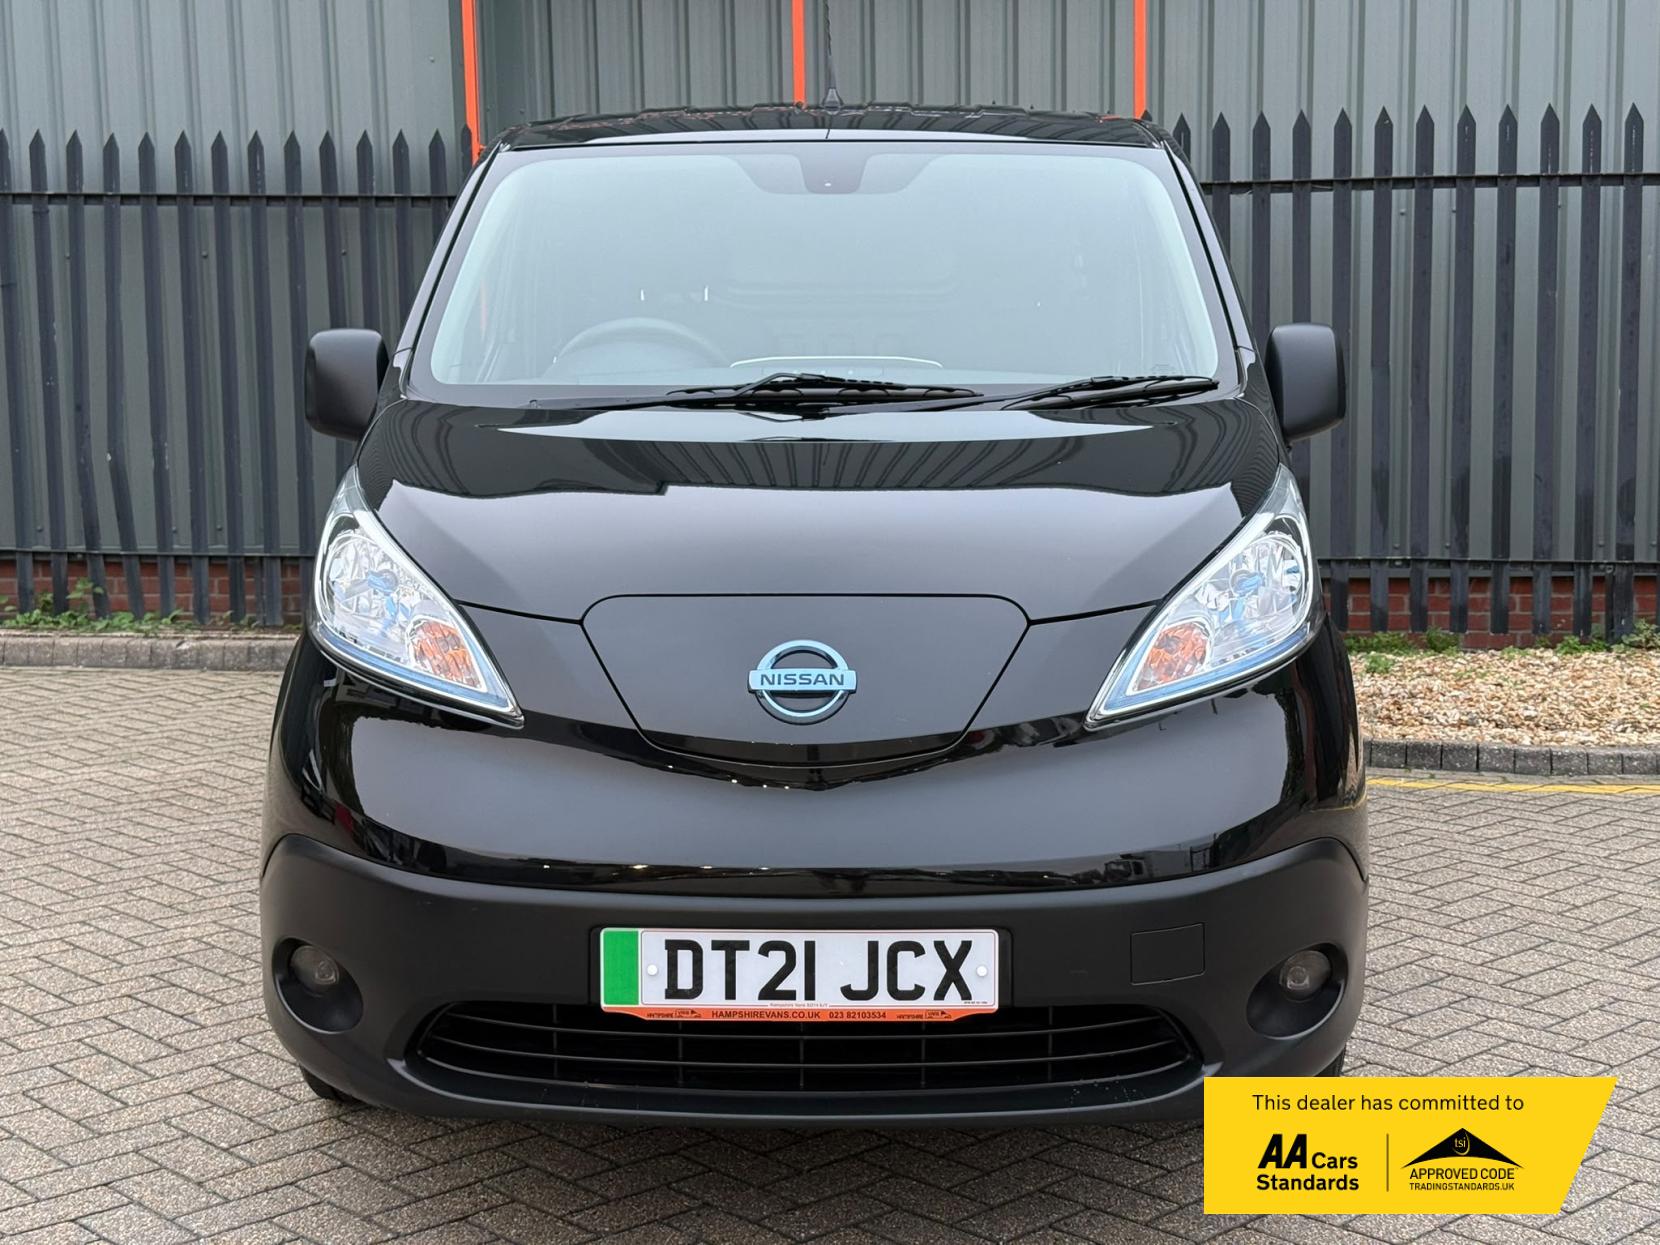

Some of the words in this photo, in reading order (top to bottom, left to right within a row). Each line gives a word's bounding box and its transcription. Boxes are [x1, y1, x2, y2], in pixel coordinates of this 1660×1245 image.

[760, 673, 845, 686] NISSAN
[664, 939, 816, 1001] DT21
[839, 940, 973, 1001] JCX
[711, 1010, 821, 1019] HAMPSHIREVANS.CO.UK
[828, 1010, 844, 1019] 023
[846, 1010, 887, 1019] 82103534
